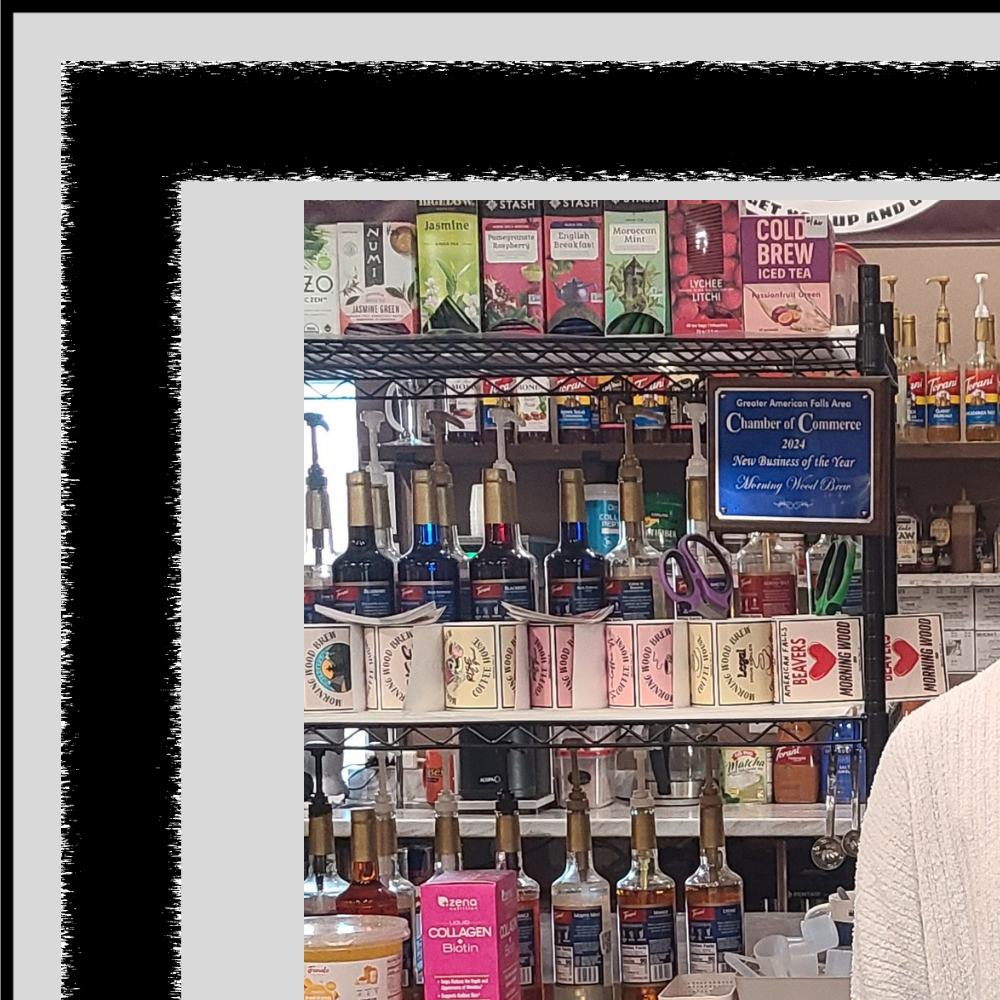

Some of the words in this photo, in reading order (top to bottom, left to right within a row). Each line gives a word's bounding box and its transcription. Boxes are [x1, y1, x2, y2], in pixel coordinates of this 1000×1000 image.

[500, 200, 535, 210] STASH
[833, 214, 860, 227] UP
[866, 201, 906, 224] AND
[424, 220, 470, 231] Jasmine
[557, 232, 590, 241] English
[612, 226, 657, 235] Moroccan
[756, 219, 805, 241] COLD
[553, 240, 597, 249] Breakfast
[623, 235, 646, 244] Mint
[366, 227, 382, 278] NUMI
[757, 242, 814, 265] BREW
[689, 278, 723, 288] LYCHEE
[758, 268, 786, 279] ICED
[788, 268, 812, 279] TEA
[692, 292, 721, 302] LITCHI
[352, 305, 379, 313] JASMINE
[380, 305, 400, 313] GREEN
[928, 376, 958, 395] Torani
[966, 374, 993, 393] Torani
[736, 399, 767, 408] Greater
[769, 398, 808, 408] American
[810, 399, 830, 408] Falls
[831, 399, 852, 408] Area
[726, 412, 781, 433] Chamber
[784, 417, 795, 430] of
[798, 412, 862, 434] Commerce
[781, 438, 806, 449] 2024
[732, 455, 757, 467] New
[758, 455, 799, 467] Business
[802, 456, 813, 471] of
[815, 455, 829, 467] the
[832, 456, 856, 468] Year
[735, 474, 783, 496] Morning
[786, 474, 818, 491] Wood
[820, 476, 852, 491] Brew
[312, 630, 337, 650] BREW
[728, 625, 752, 645] BREW
[836, 621, 851, 651] WOOD
[918, 618, 933, 647] WOOD
[472, 637, 491, 664] HOUSE
[504, 646, 514, 675] WOOD
[559, 647, 571, 675] WOOD
[641, 646, 652, 673] WOOD
[650, 627, 673, 647] BREW
[720, 644, 732, 672] WOOD
[305, 649, 316, 676] WOOD
[382, 649, 393, 675] WOOD
[736, 648, 749, 679] Legal
[790, 637, 808, 686] BEAVERS
[919, 648, 938, 693] MORNING
[471, 666, 492, 698] COFFEE
[783, 654, 791, 697] AMERICAN
[838, 652, 854, 697] MORNING
[307, 678, 342, 707] MORNING
[723, 673, 756, 702] MORNING
[726, 757, 766, 773] Matcha
[449, 897, 478, 907] zena
[428, 926, 492, 938] COLLAGEN
[442, 942, 479, 954] Biotin
